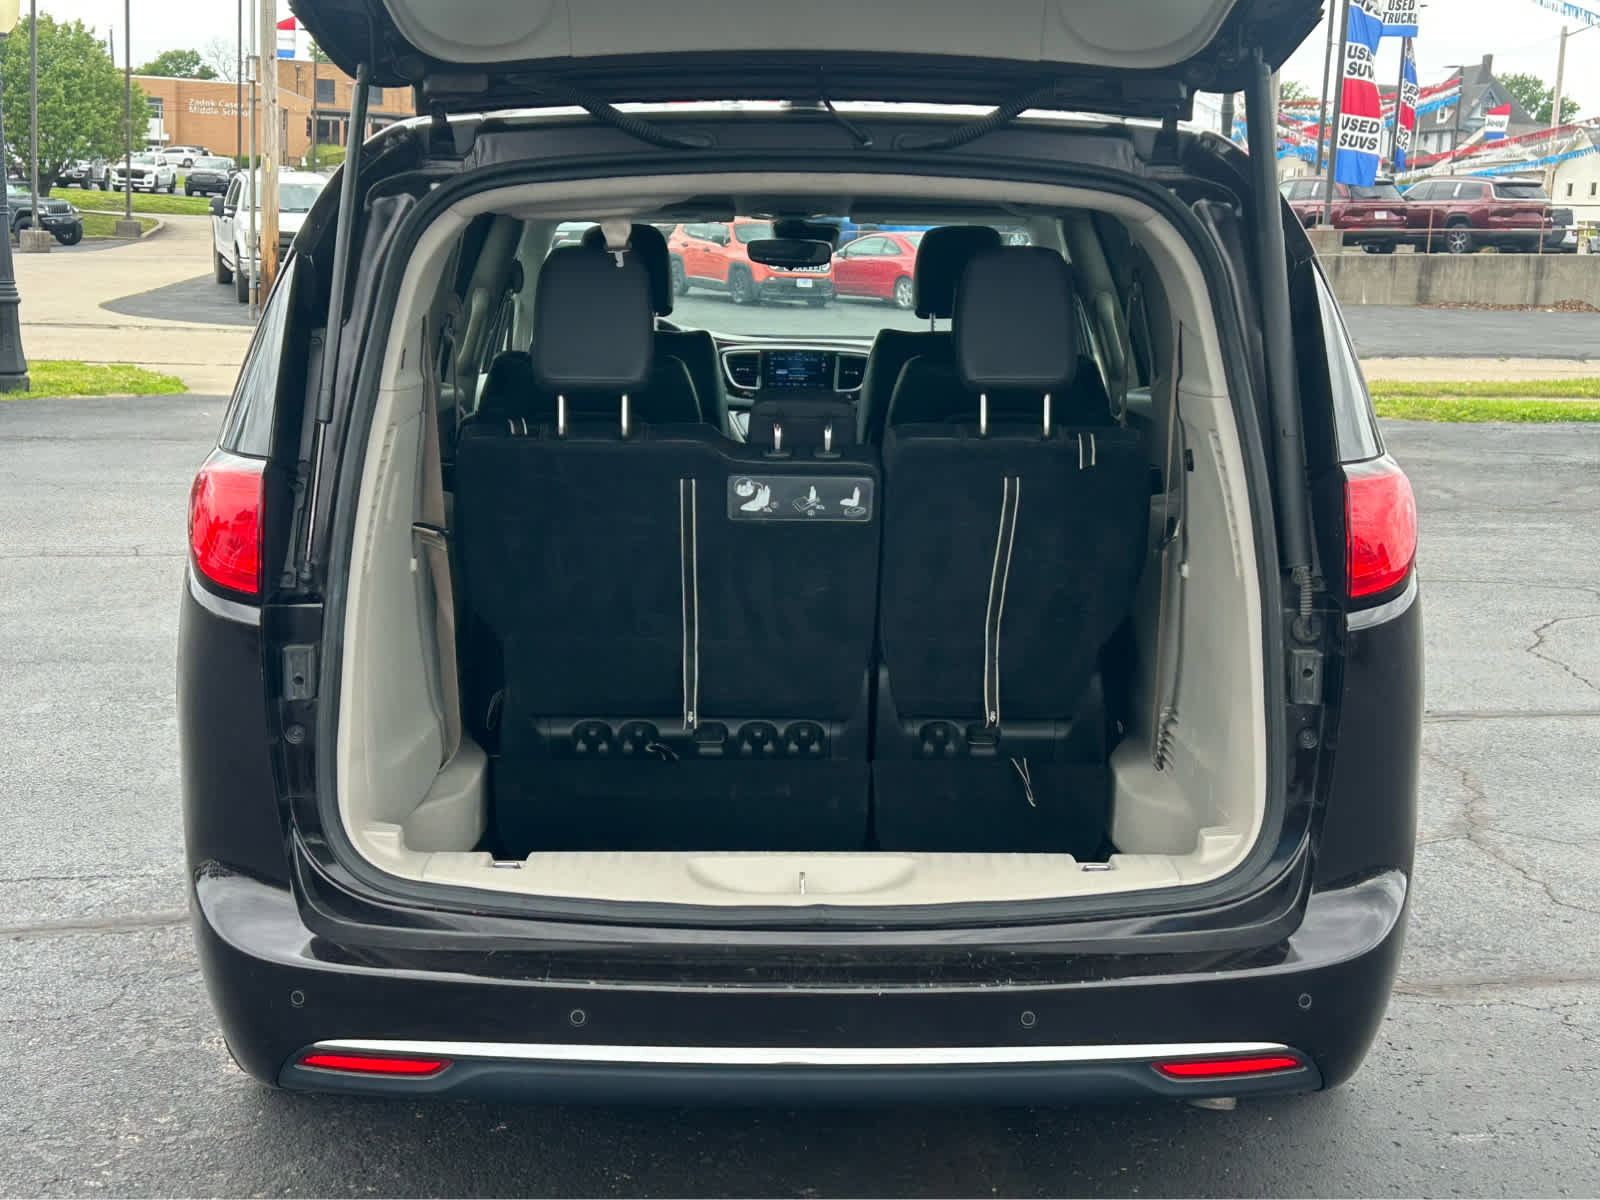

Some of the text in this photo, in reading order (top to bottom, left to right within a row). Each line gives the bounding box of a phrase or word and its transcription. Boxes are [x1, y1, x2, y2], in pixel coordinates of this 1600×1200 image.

[1388, 0, 1415, 11] USED
[1347, 45, 1372, 61] USE
[1346, 61, 1373, 79] SUV
[189, 104, 219, 114] Middle
[1341, 115, 1380, 134] USED
[1339, 133, 1378, 150] SUVS
